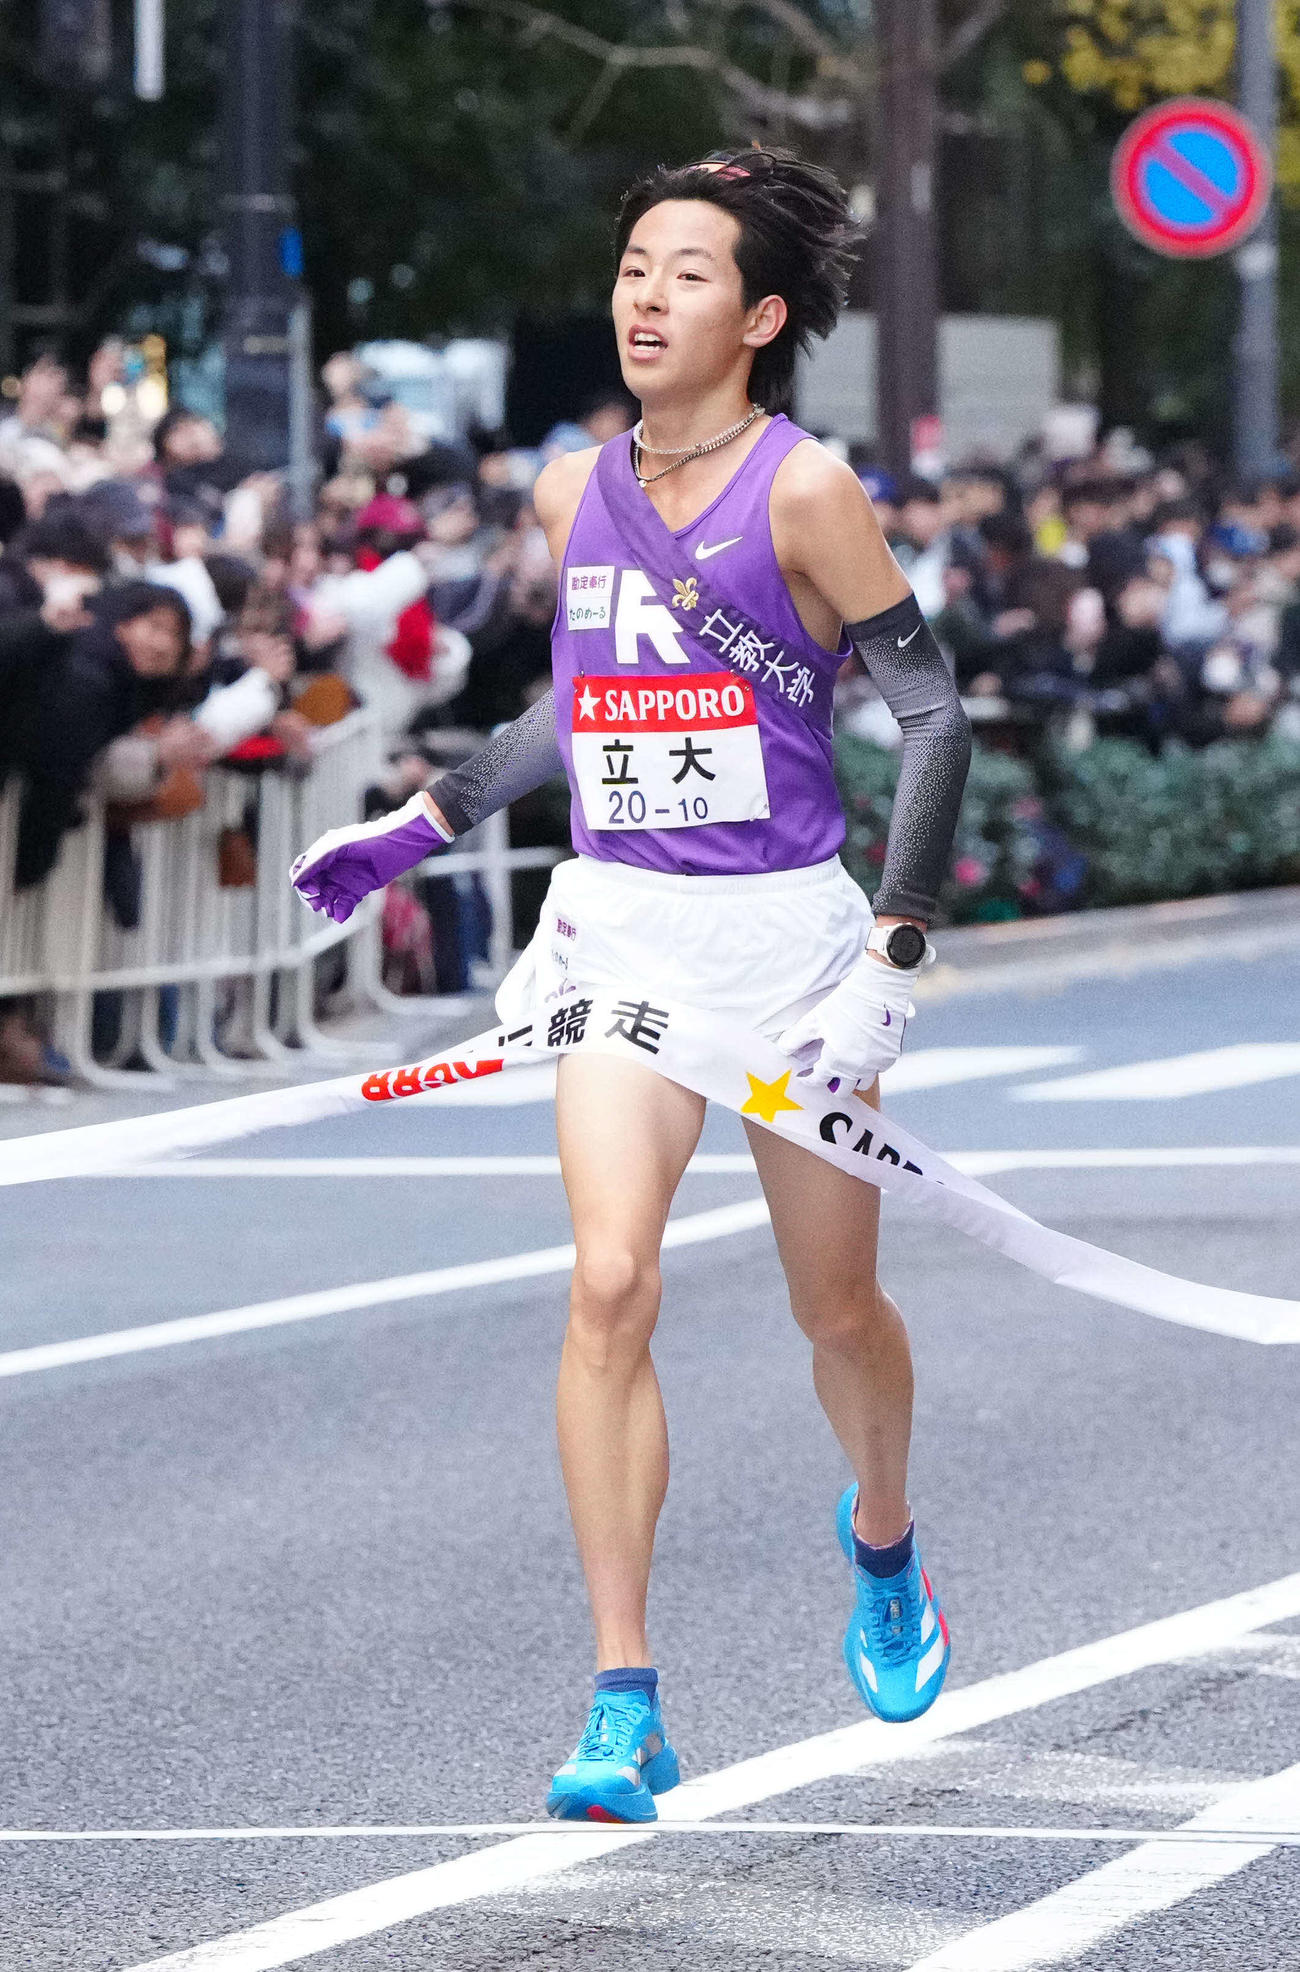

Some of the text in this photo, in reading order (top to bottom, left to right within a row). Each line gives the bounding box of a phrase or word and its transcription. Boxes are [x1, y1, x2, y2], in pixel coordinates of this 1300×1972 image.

[569, 606, 606, 621] たのめーる
[615, 569, 691, 664] R
[699, 608, 816, 707] 立教大学
[604, 685, 746, 721] SAPPORO
[607, 790, 709, 824] 20-10
